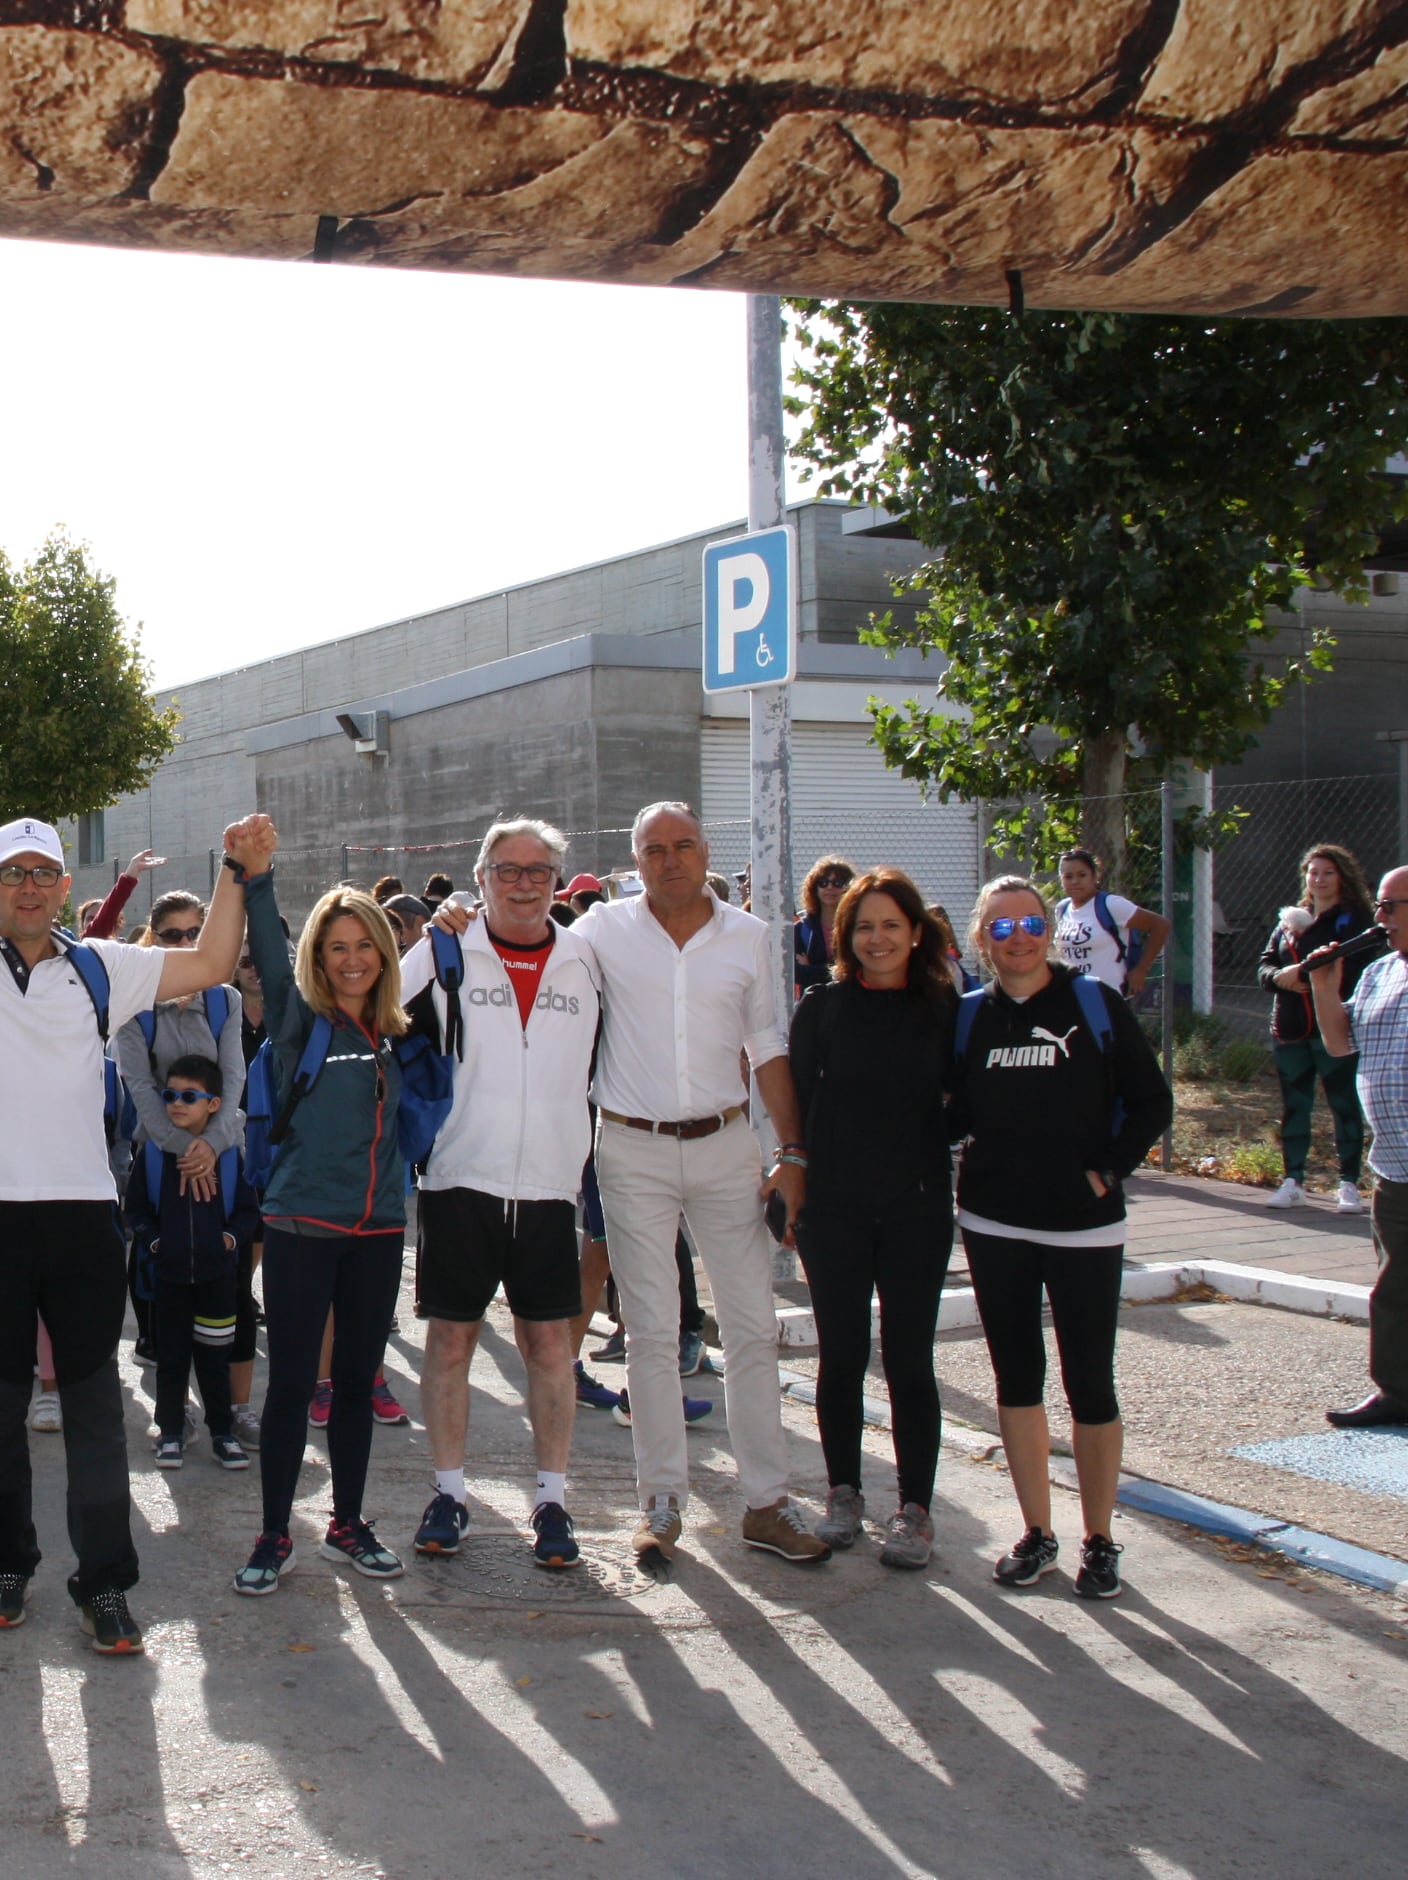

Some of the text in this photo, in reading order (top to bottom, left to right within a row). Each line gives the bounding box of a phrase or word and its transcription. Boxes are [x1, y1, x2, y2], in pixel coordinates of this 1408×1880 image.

[717, 553, 770, 675] P
[502, 958, 538, 971] hummel
[985, 1045, 1056, 1069] PUMA
